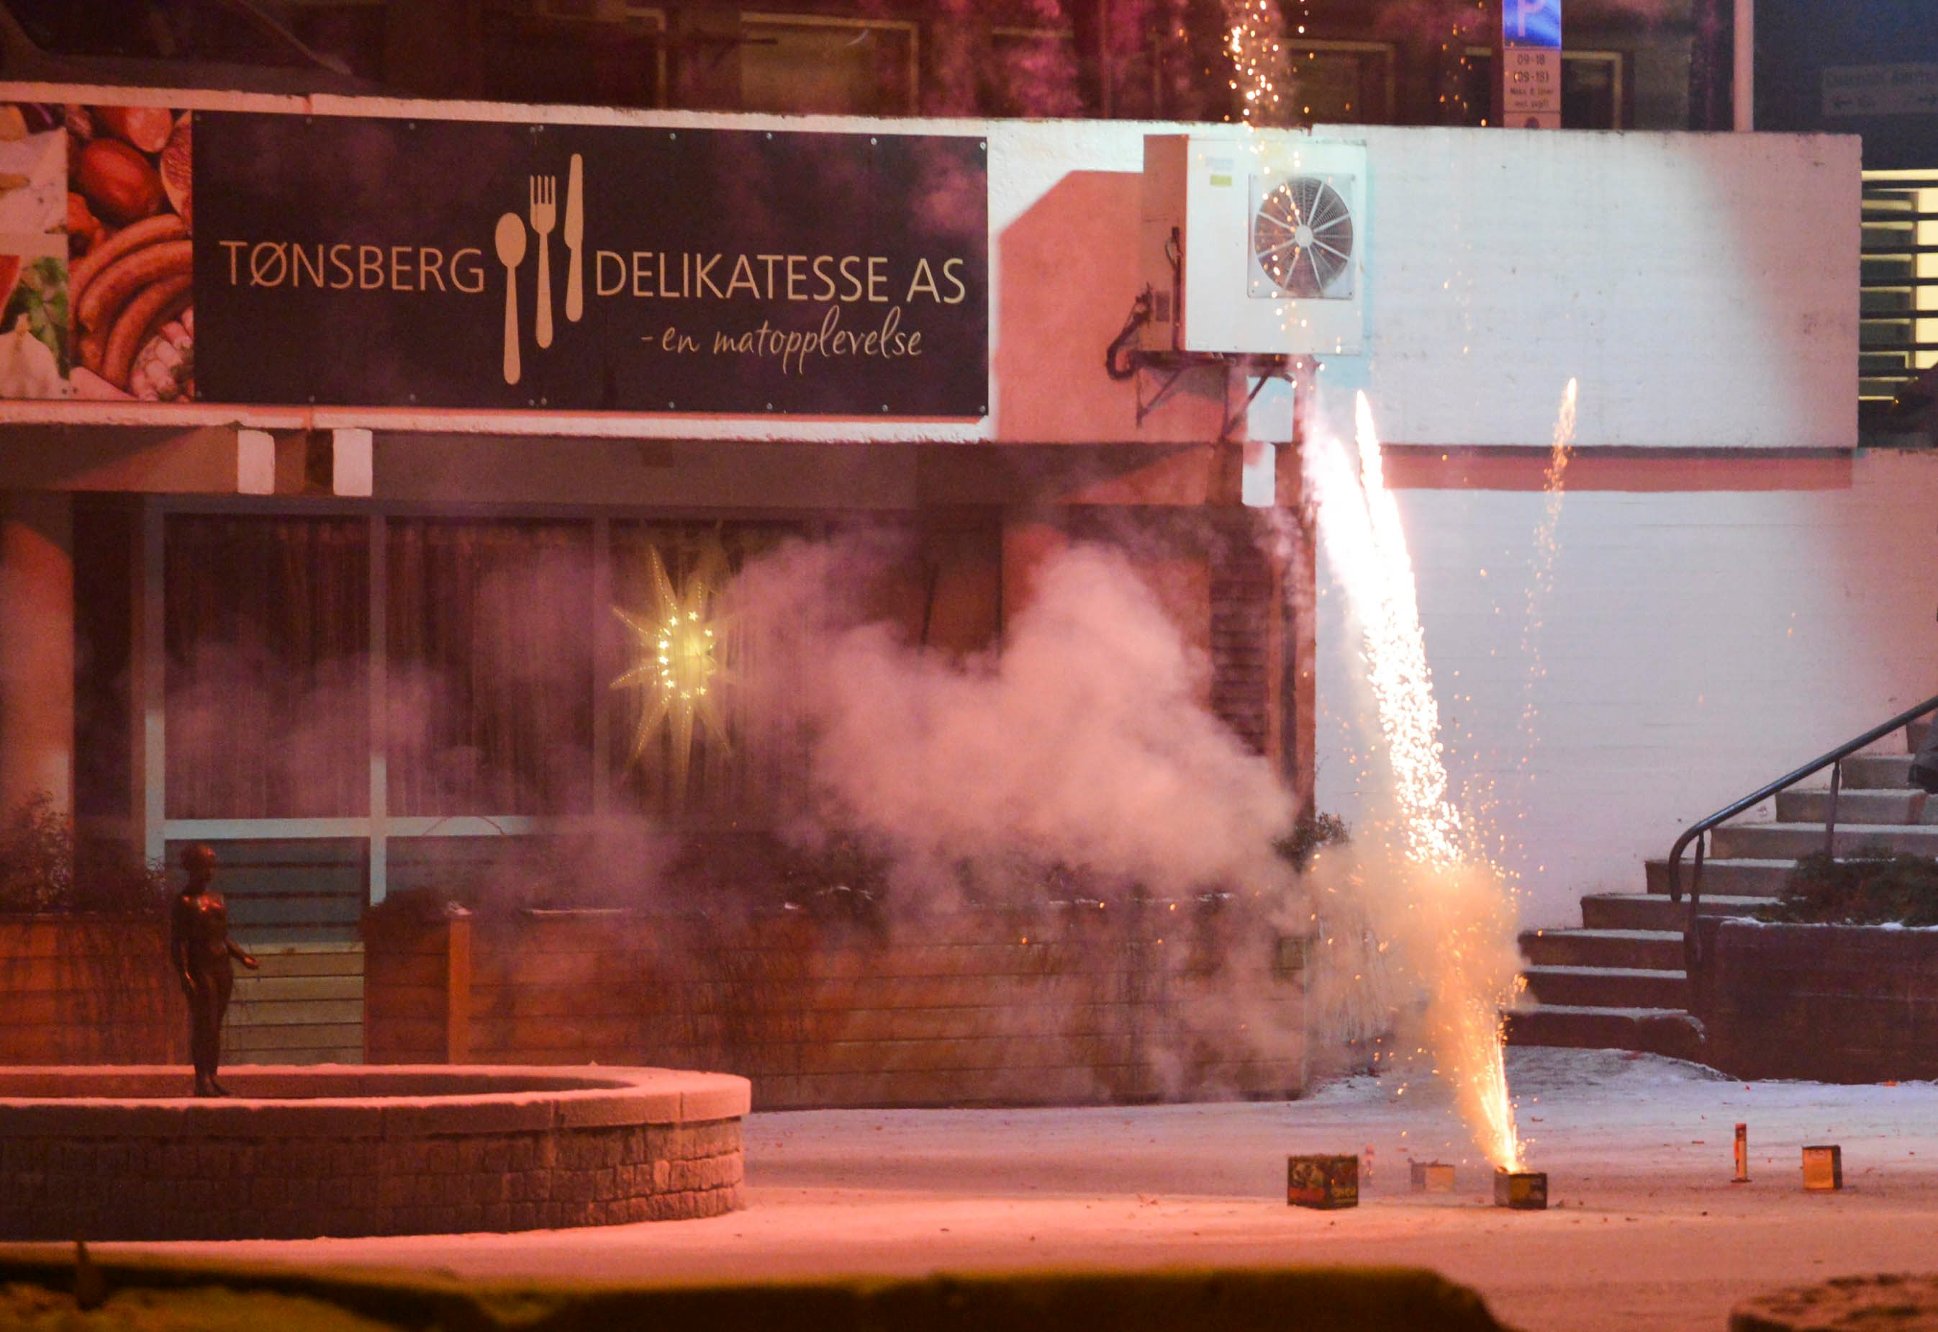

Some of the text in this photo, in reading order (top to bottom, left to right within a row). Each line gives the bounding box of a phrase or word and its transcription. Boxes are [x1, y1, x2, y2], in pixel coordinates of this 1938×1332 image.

[219, 240, 966, 304] TØNSBERG DELIKATESSE AS
[713, 305, 922, 374] matopplevelse
